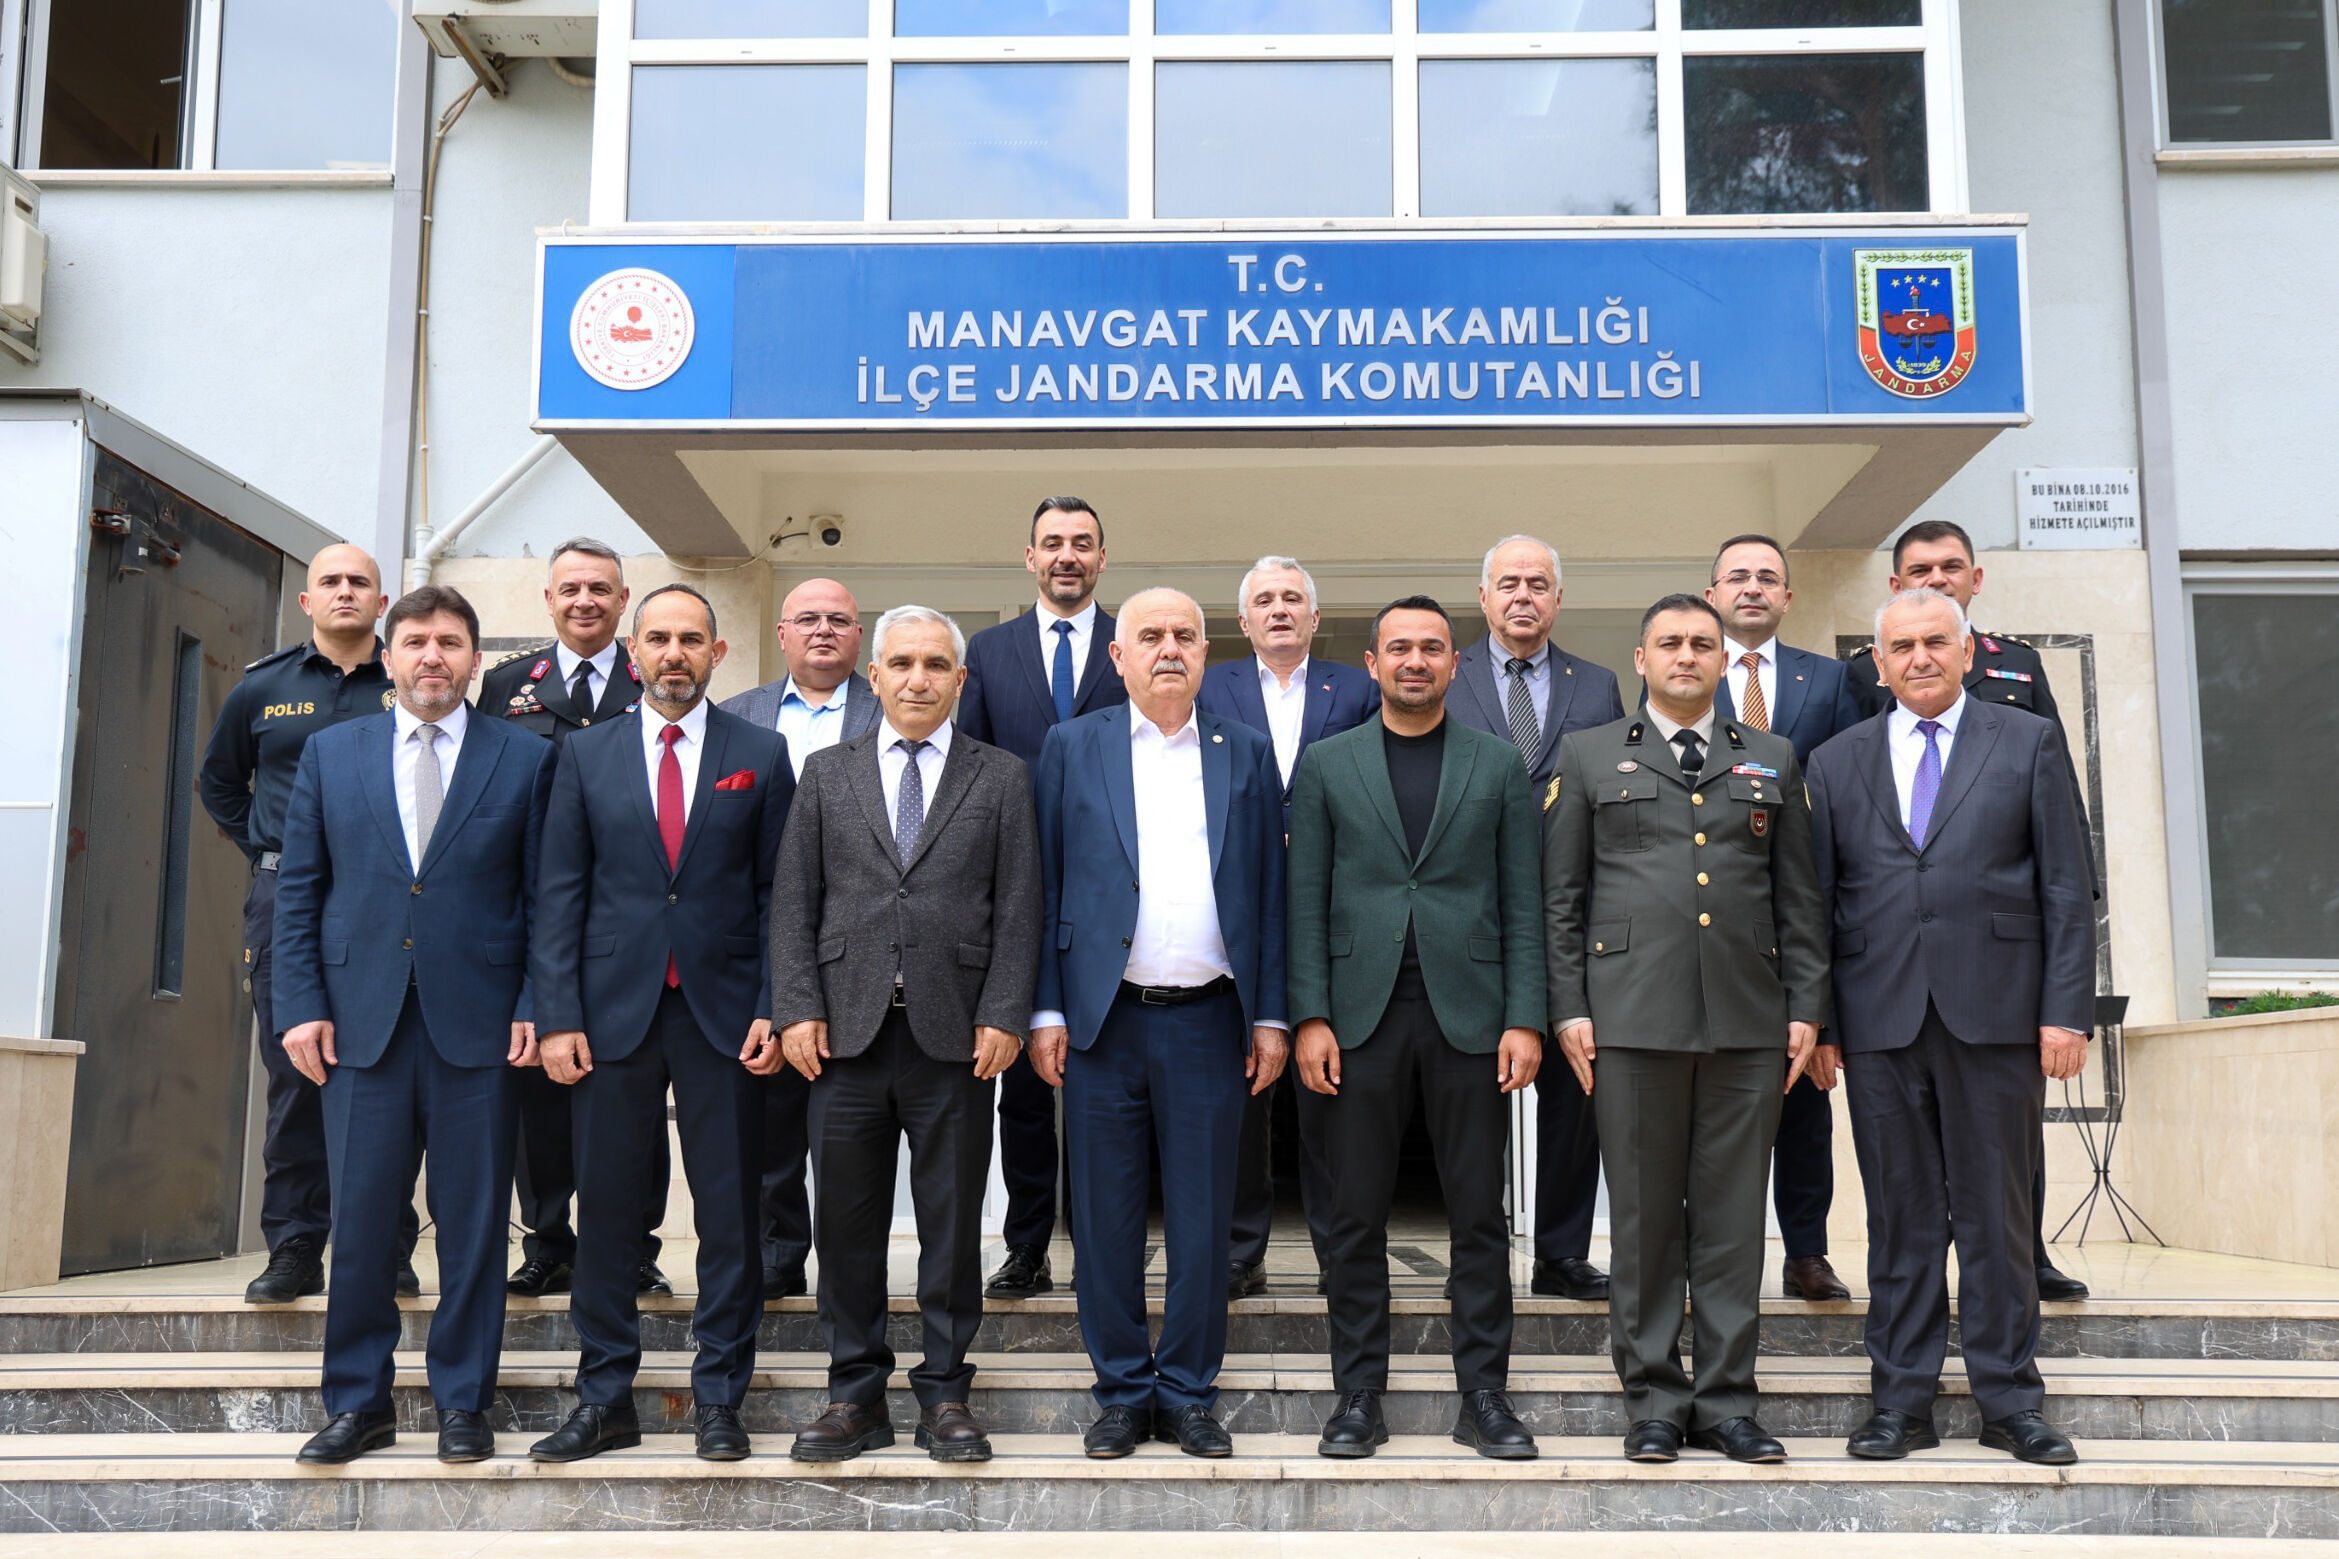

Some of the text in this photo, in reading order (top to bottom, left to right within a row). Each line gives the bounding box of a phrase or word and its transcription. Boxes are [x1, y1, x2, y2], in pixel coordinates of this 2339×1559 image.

[1228, 254, 1324, 292] T.C.
[907, 296, 1649, 348] MANAVGAT KAYMAKAMLIĞI
[857, 350, 1700, 411] İLÇE JANDARMA KOMUTANLIĞI
[1864, 351, 1972, 394] JANDARMA
[2032, 481, 2129, 495] BU BİNA 08.10.2016
[2053, 498, 2109, 512] TARİHİNDE
[2030, 515, 2135, 531] HİZMETE AÇILMIŞTIR
